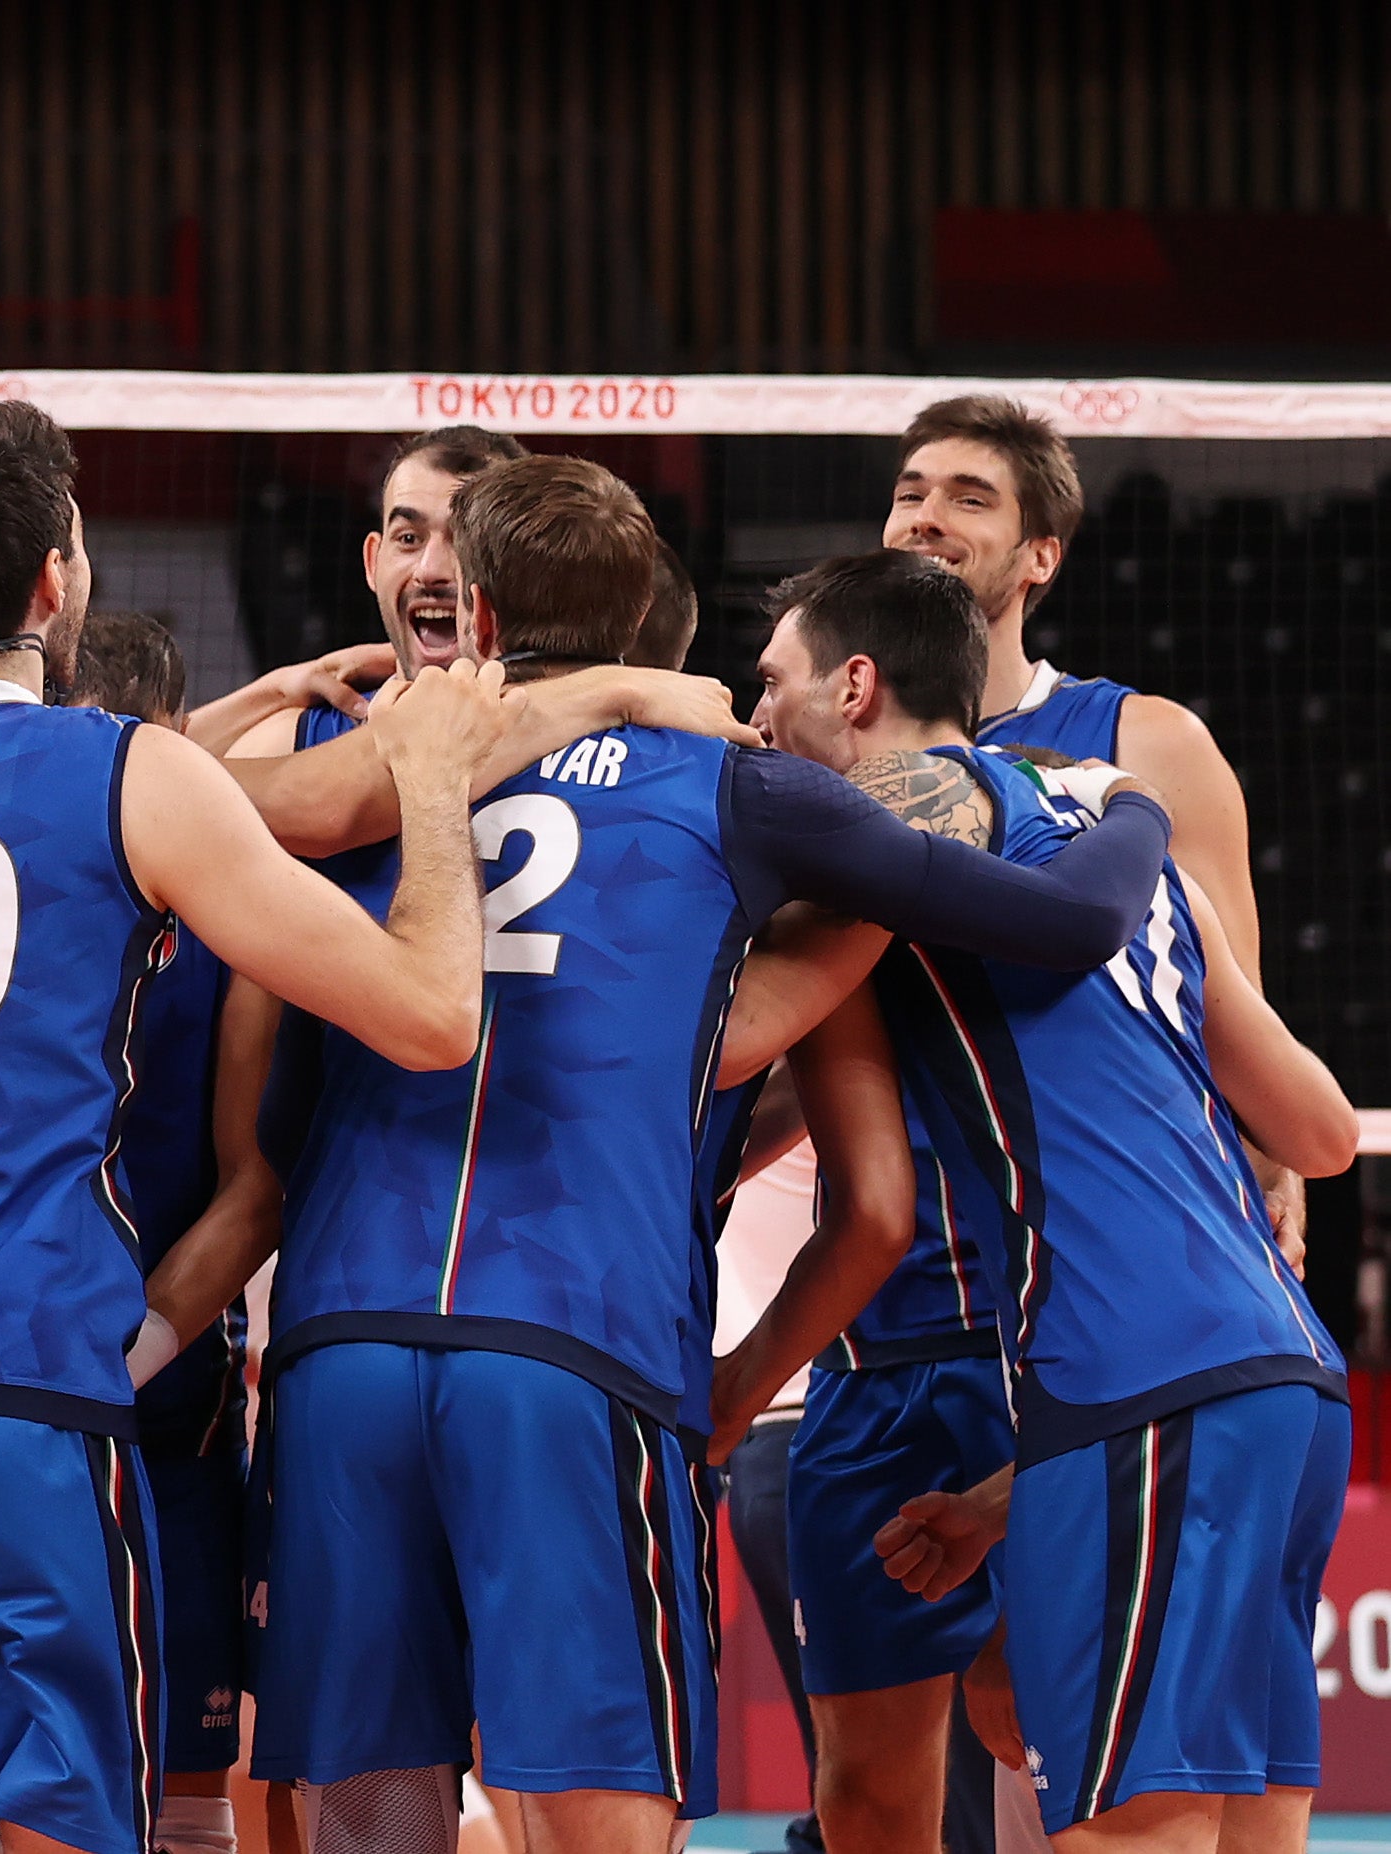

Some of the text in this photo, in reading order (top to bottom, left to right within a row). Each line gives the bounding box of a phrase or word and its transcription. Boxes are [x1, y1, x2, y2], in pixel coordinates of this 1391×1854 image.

[412, 377, 676, 420] TOKYO 2020
[470, 793, 581, 975] 2
